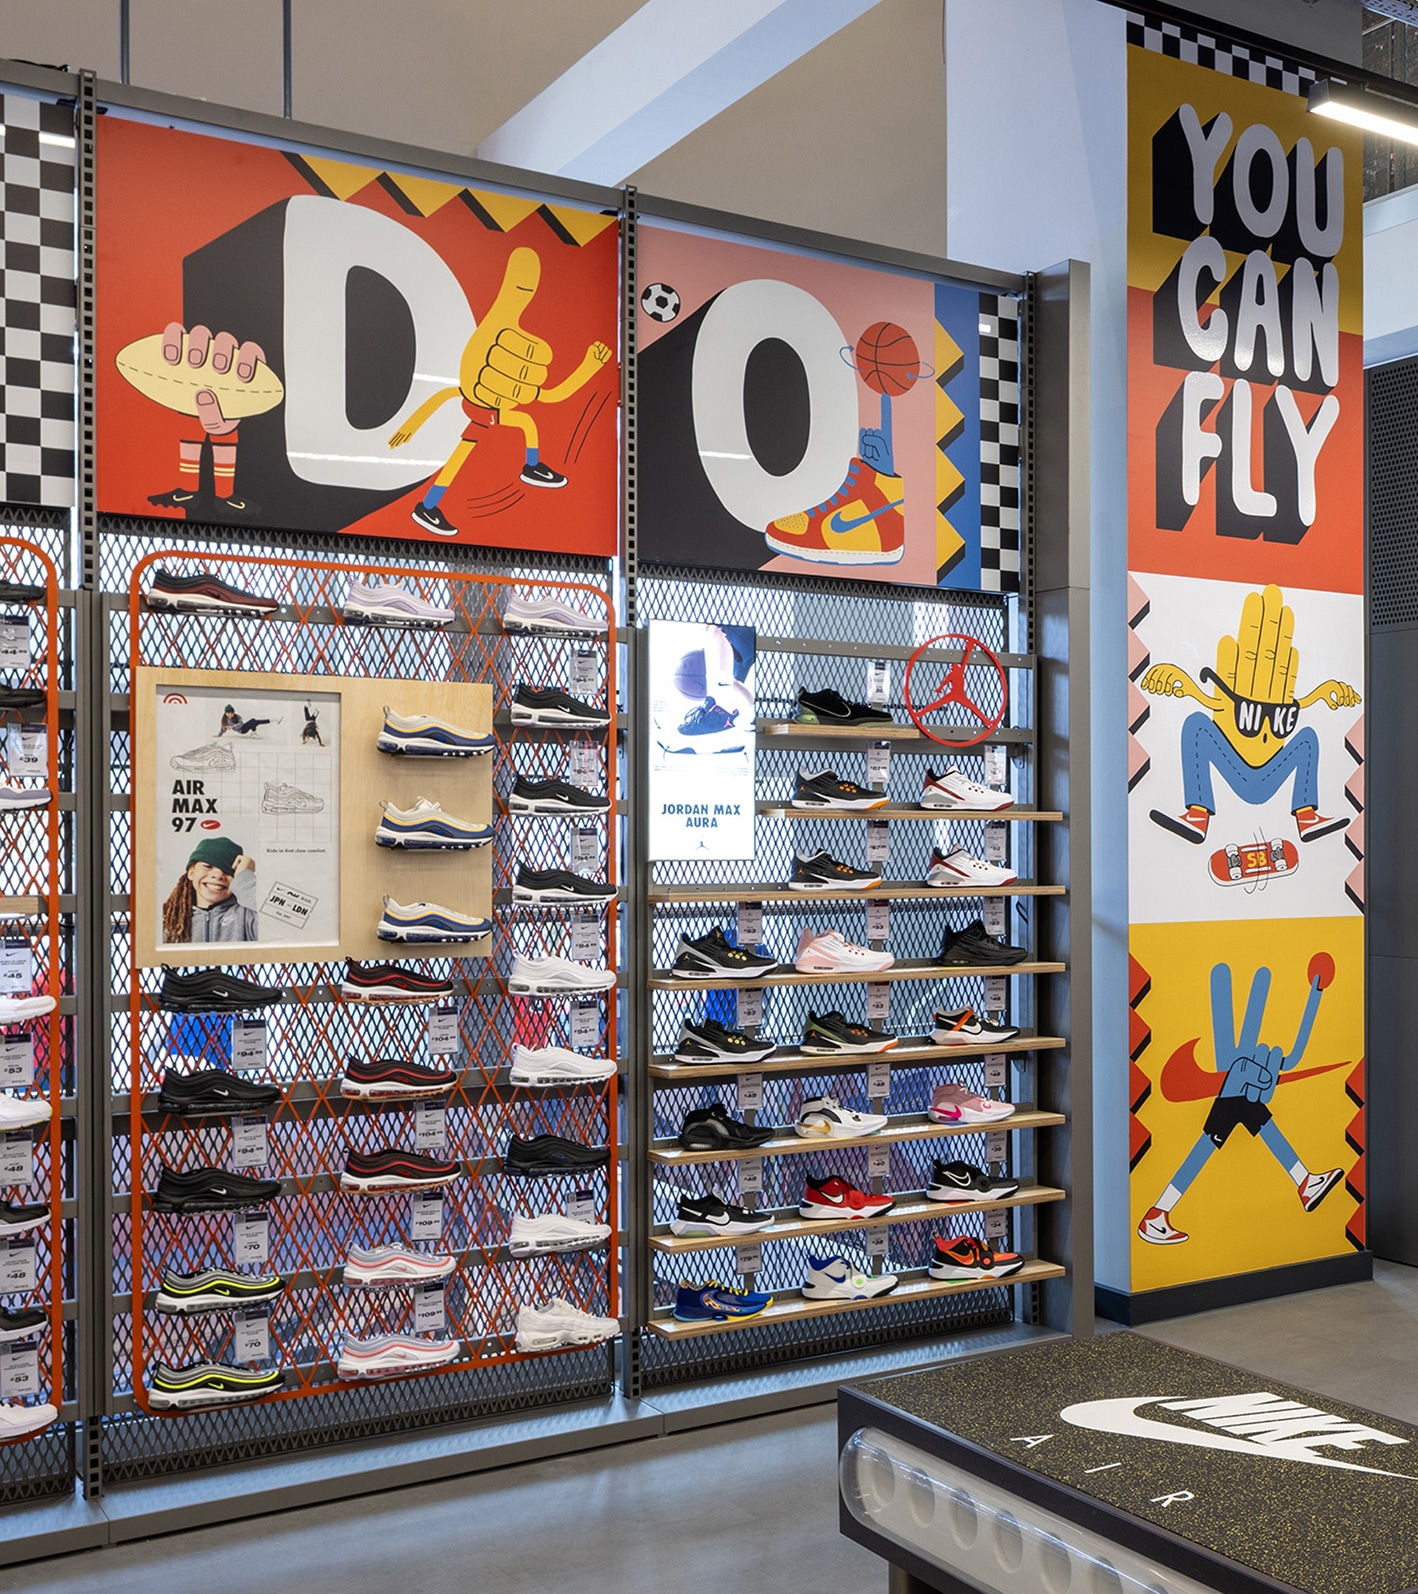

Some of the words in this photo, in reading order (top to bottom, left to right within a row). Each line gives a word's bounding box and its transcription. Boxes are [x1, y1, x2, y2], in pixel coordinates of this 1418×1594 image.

[1178, 103, 1344, 257] YOU
[1177, 236, 1340, 387] CAN
[1181, 371, 1340, 527] FLY
[172, 780, 205, 795] AIR
[171, 798, 218, 814] MAX
[661, 803, 709, 815] JORDAN
[713, 804, 741, 816] MAX
[171, 817, 197, 833] 97
[685, 817, 718, 828] AURA
[1246, 852, 1267, 868] SB
[269, 895, 286, 907] JPN
[291, 904, 309, 916] LDN
[1157, 1391, 1410, 1457] NIKE
